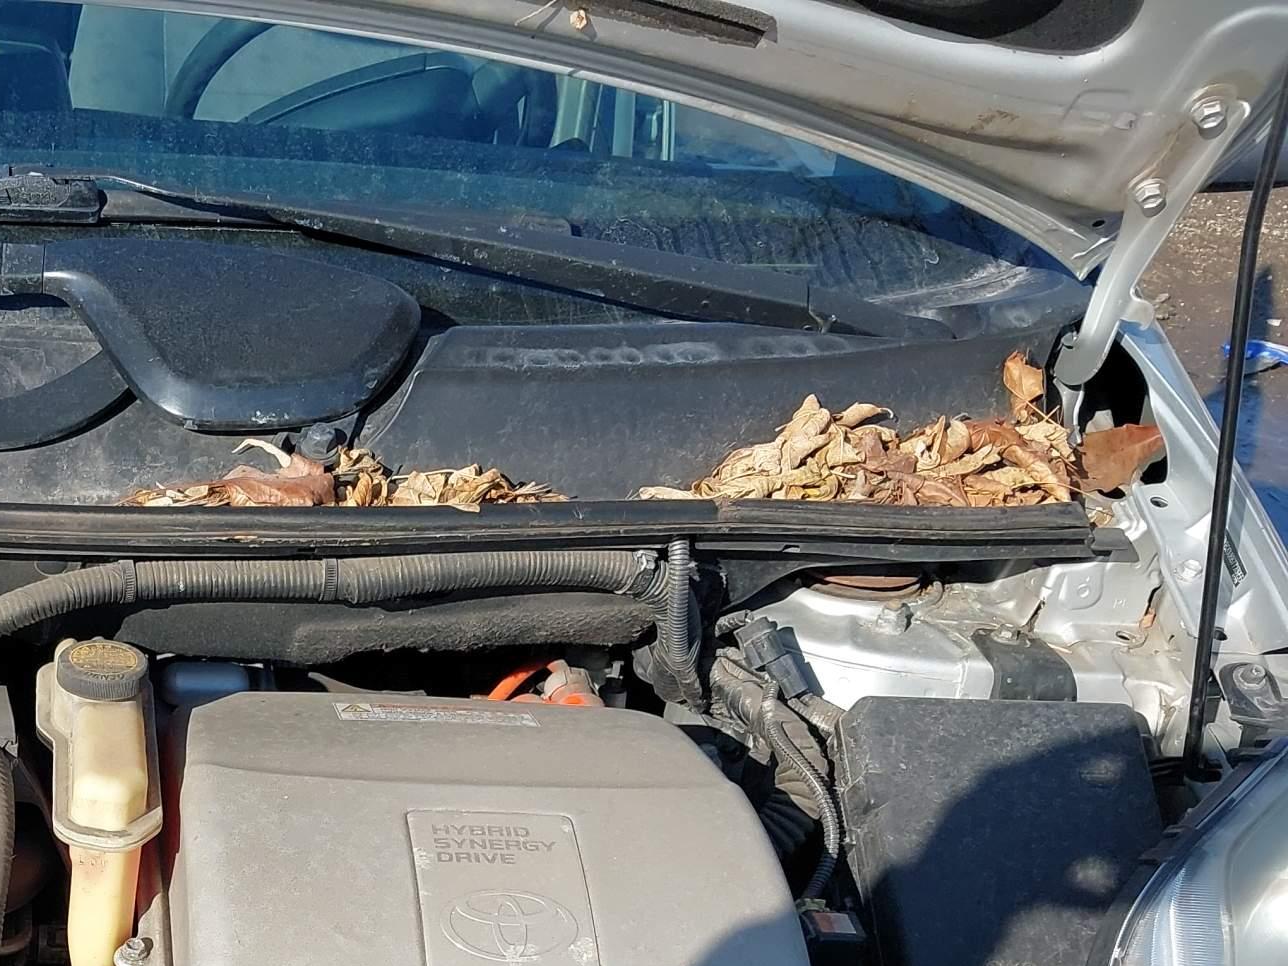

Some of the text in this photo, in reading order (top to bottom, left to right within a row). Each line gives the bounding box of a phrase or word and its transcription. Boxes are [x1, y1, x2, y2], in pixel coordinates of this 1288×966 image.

[431, 824, 530, 837] HYBRID
[434, 838, 556, 851] SYNERGY
[437, 851, 516, 864] DRIVE
